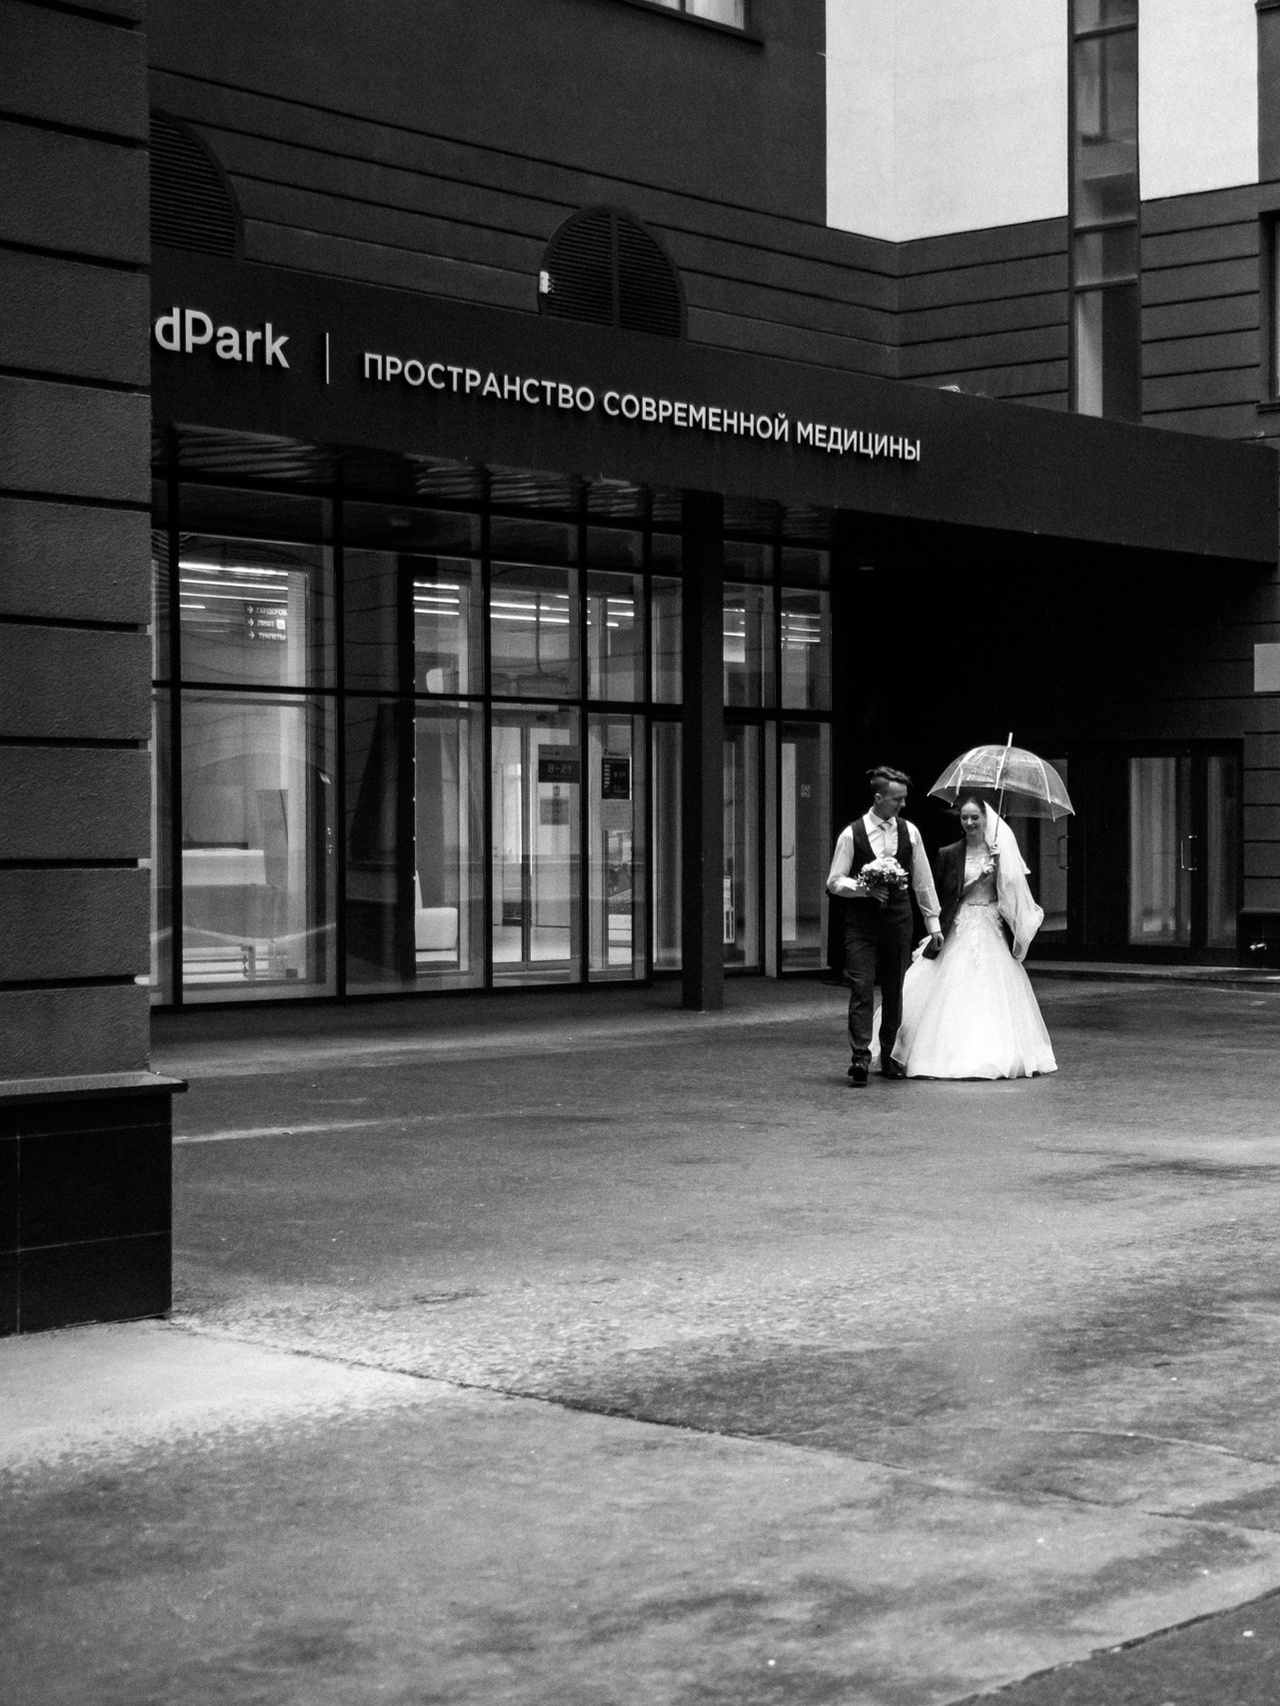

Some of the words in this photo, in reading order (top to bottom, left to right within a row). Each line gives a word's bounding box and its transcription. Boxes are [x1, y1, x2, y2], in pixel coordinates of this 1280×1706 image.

[149, 307, 290, 369] dPark
[364, 352, 595, 412] ПРОСТРАНСТВО
[603, 391, 789, 443] СОВРЕМЕННОЙ
[796, 420, 921, 462] МЕДИЦИНЫ
